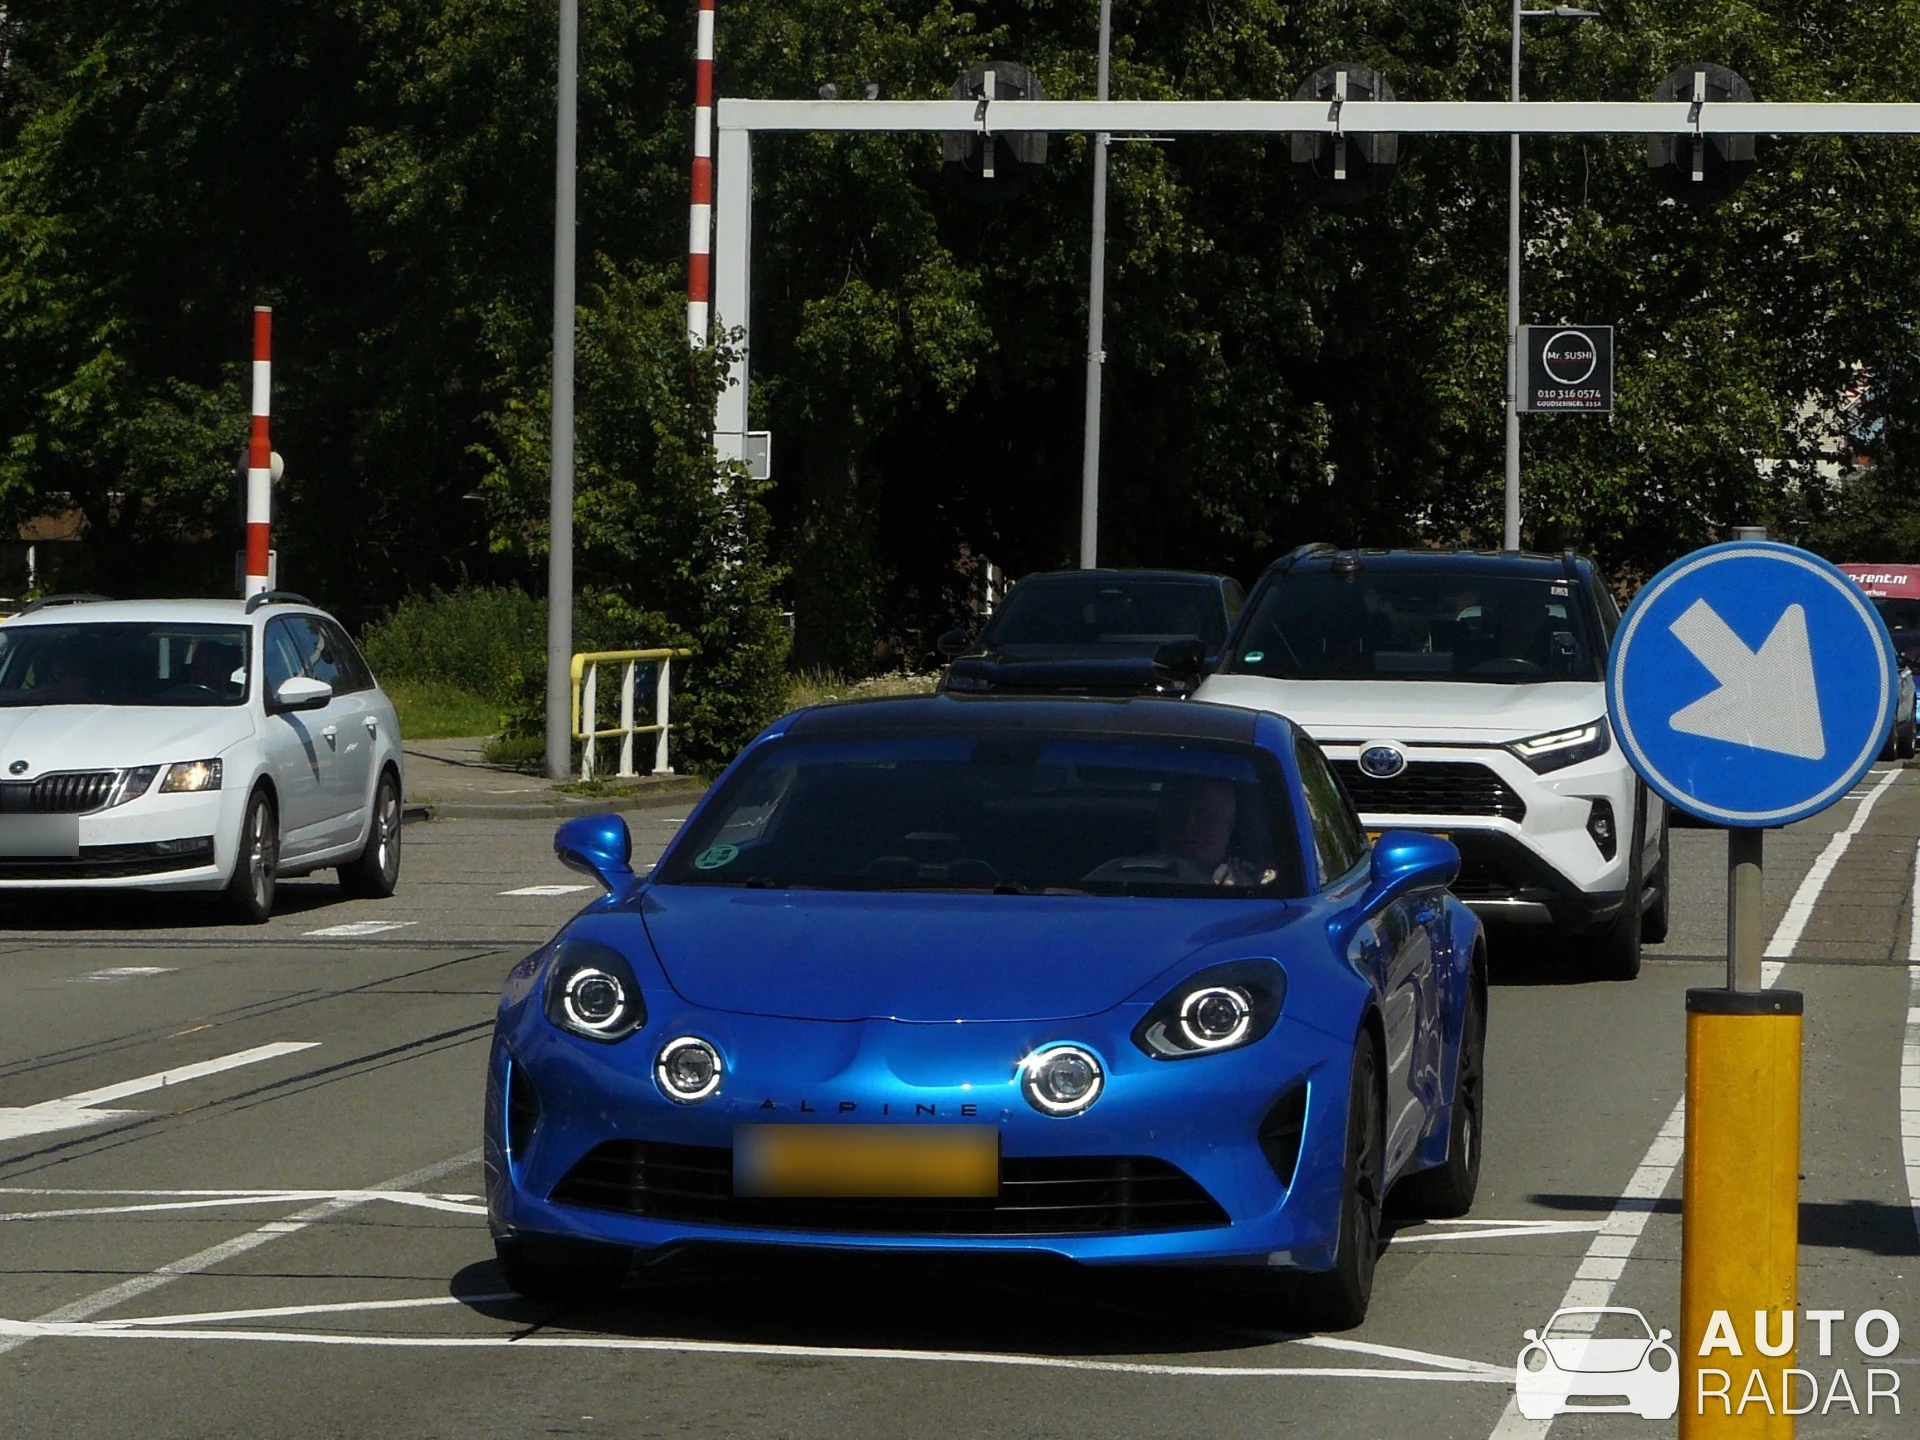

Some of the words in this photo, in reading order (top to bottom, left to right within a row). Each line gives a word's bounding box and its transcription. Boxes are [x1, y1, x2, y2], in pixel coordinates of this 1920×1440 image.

[1547, 351, 1562, 360] Mr.
[1564, 351, 1592, 360] SUSHI
[1537, 389, 1556, 398] 010
[1557, 389, 1576, 399] 316
[1577, 389, 1602, 399] 0574
[759, 1098, 978, 1117] ALPINE
